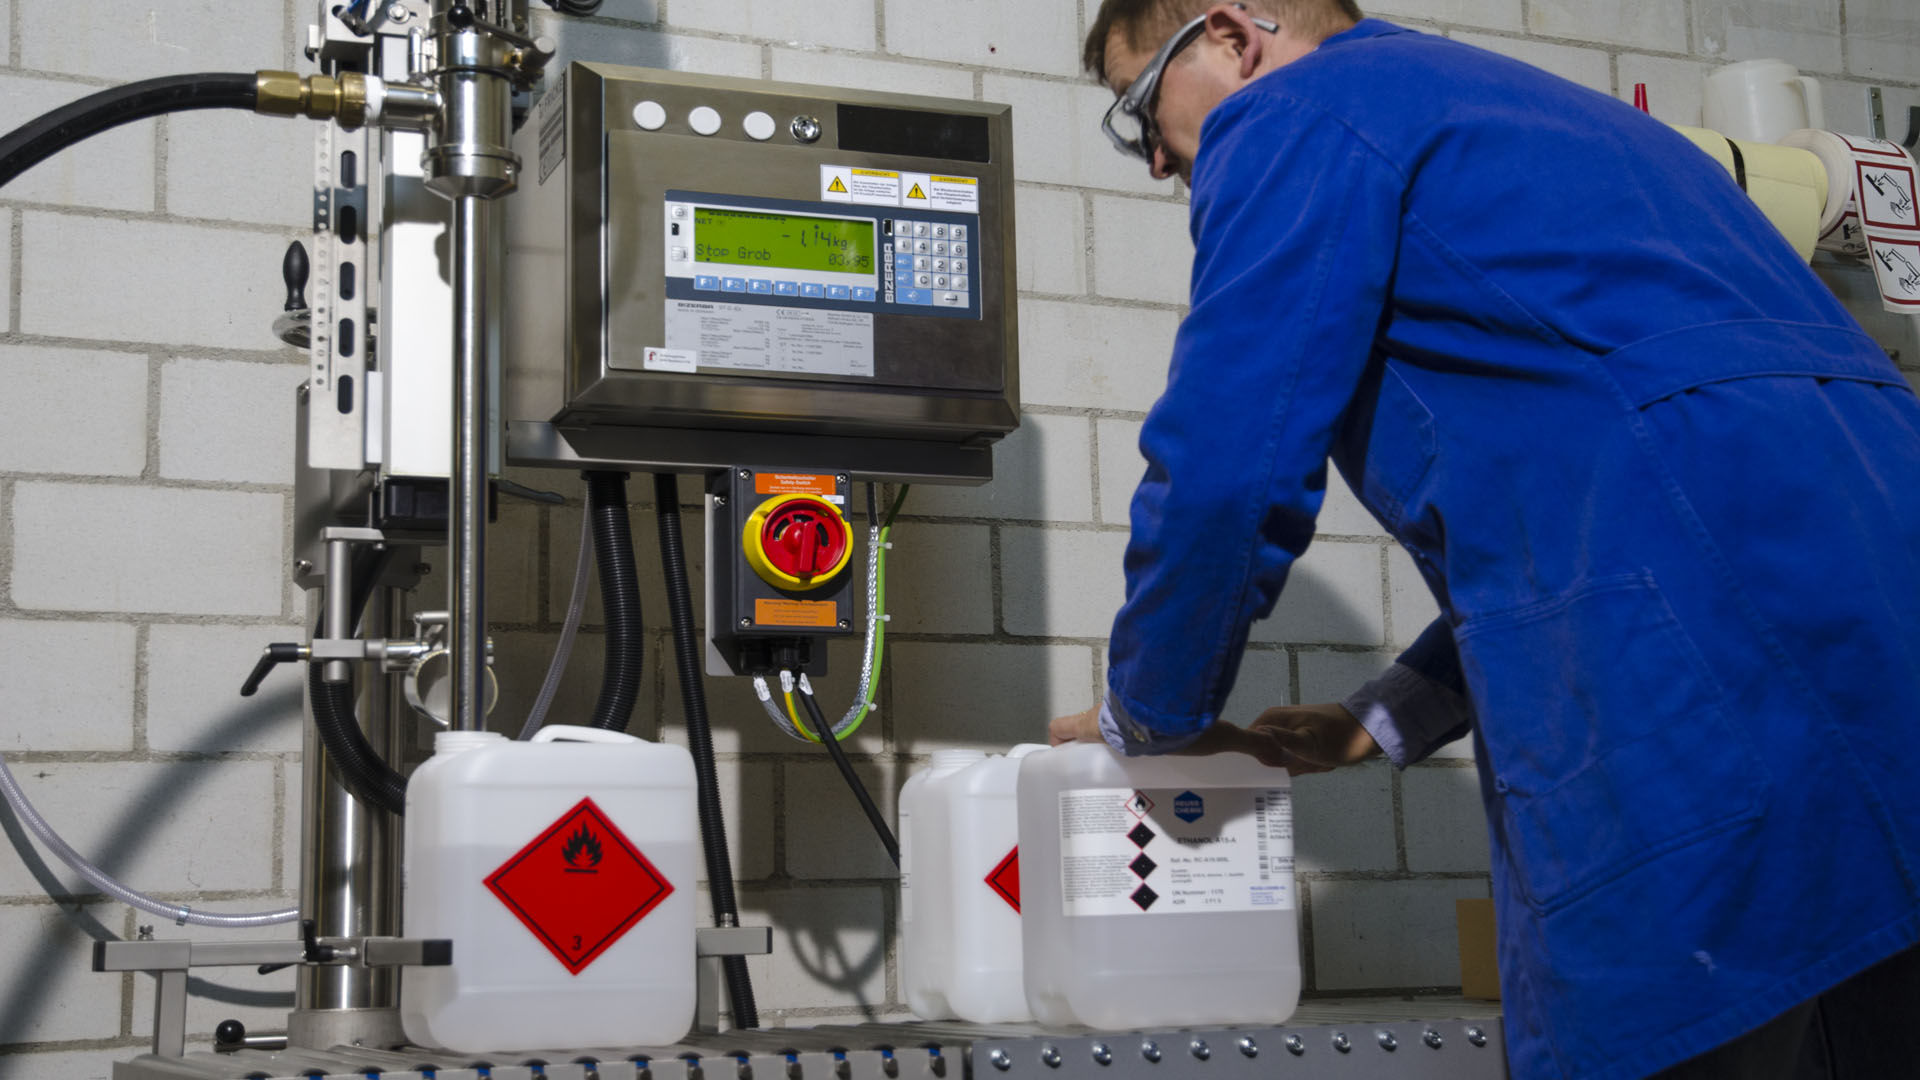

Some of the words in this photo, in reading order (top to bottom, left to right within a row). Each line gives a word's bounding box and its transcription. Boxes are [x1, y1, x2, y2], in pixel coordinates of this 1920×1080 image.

[919, 225, 925, 234] 7
[937, 227, 944, 235] 8
[955, 228, 962, 237] 9
[919, 242, 926, 250] 4
[937, 244, 944, 252] 5
[955, 245, 962, 254] 6
[938, 260, 944, 269] 2
[956, 262, 963, 270] 3
[883, 243, 894, 303] BIZERBA
[700, 277, 713, 287] F1
[726, 279, 740, 289] F2
[920, 276, 928, 284] C
[753, 281, 767, 291] F3
[779, 283, 793, 292] F4
[805, 285, 819, 294] F5
[831, 287, 844, 296] F6
[857, 289, 870, 298] F7
[1176, 836, 1214, 844] ETHANOL
[572, 935, 582, 950] 3
